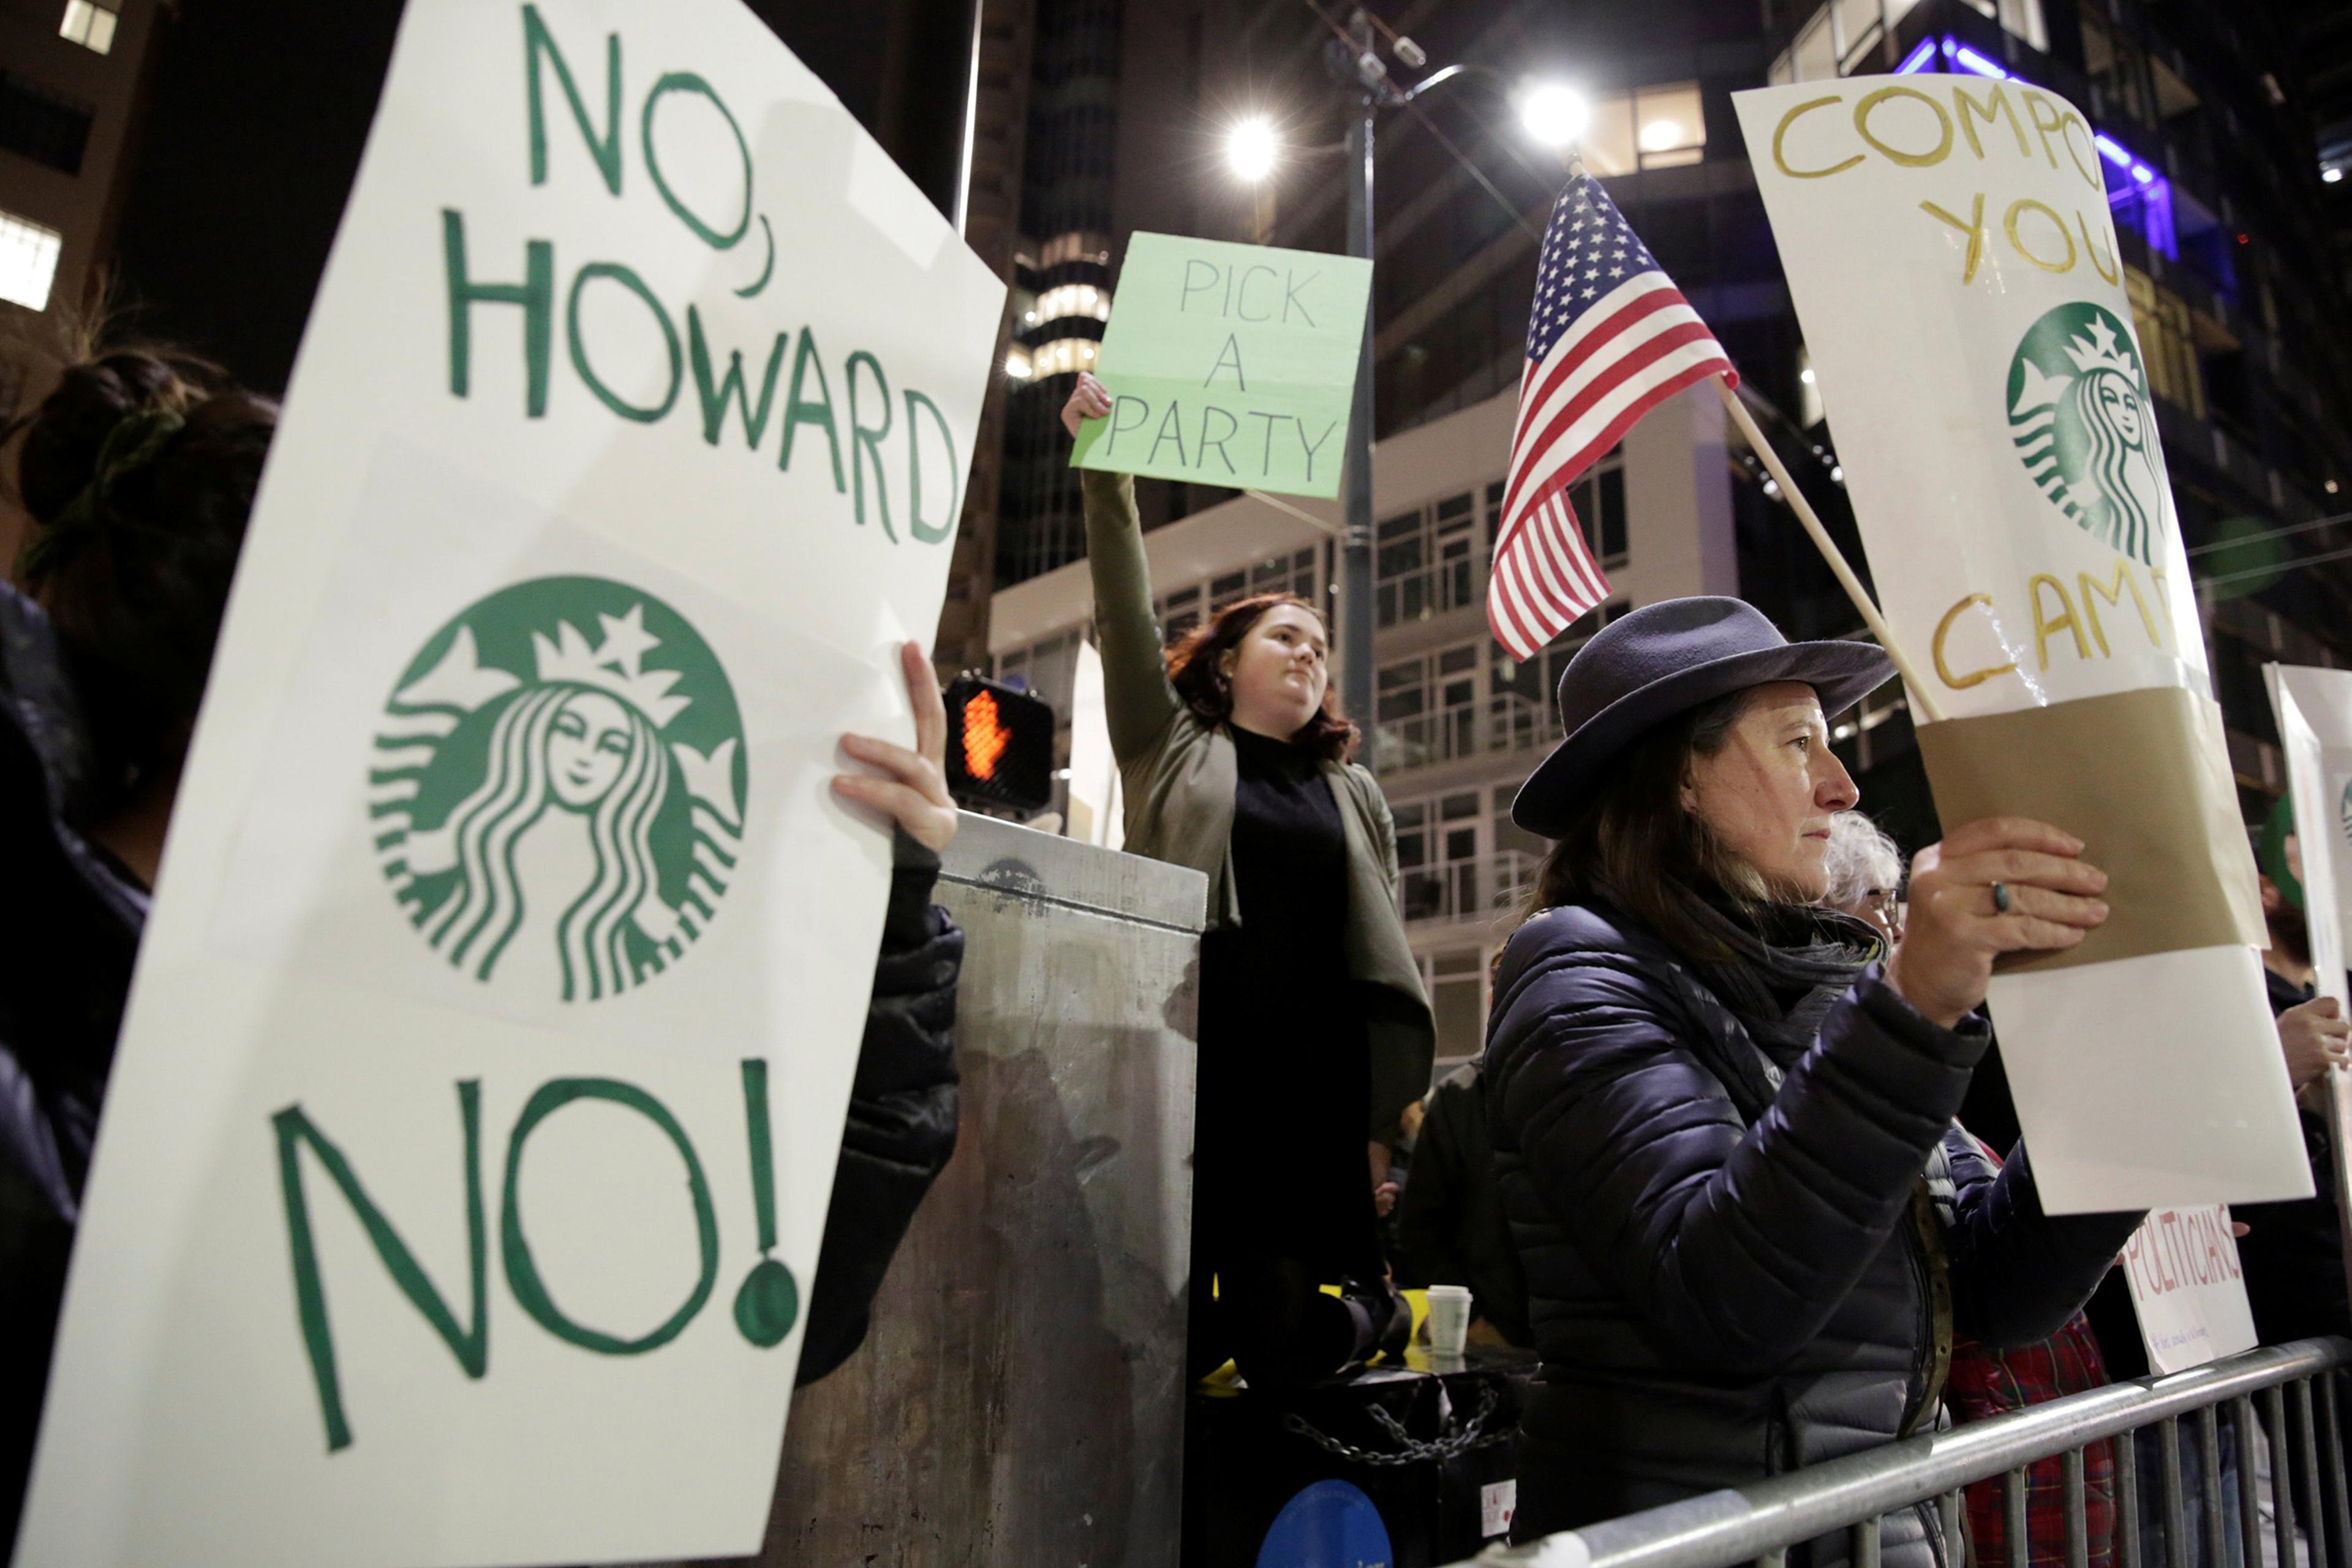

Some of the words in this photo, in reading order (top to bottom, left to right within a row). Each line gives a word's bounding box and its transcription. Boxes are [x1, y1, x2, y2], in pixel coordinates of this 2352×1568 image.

[522, 2, 774, 298] NO,
[1918, 192, 2119, 287] YOU
[1181, 259, 1321, 328] PICK
[440, 206, 959, 545] HOWARD
[1204, 333, 1245, 392] A
[1107, 394, 1337, 483] PARTY
[269, 1058, 799, 1455] NO!
